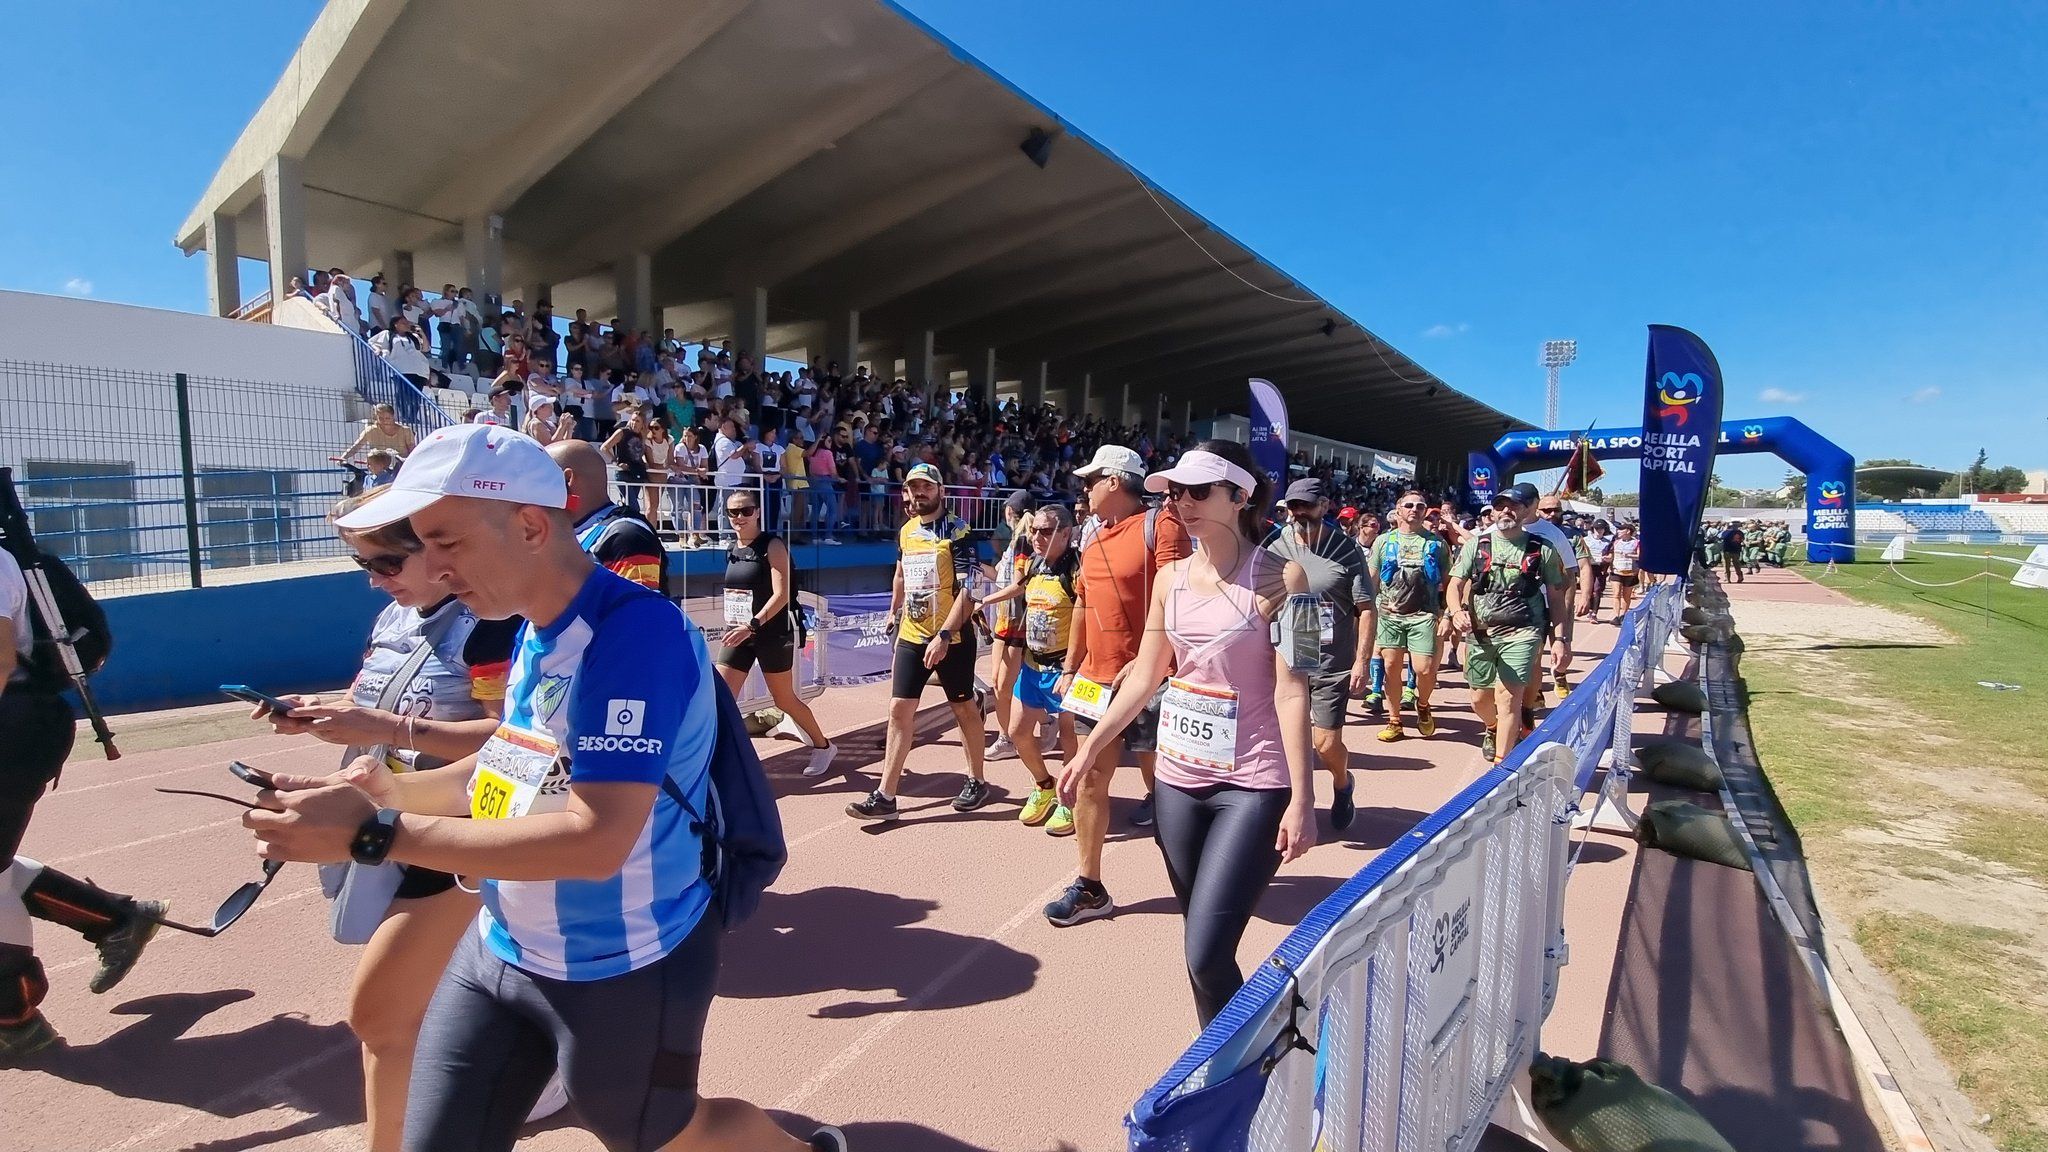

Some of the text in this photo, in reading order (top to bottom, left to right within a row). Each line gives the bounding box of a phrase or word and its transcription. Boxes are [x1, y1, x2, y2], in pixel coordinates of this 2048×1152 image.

[1549, 436, 1642, 451] MELLA SPO
[473, 480, 506, 491] RFET
[1813, 508, 1850, 516] MELILLA
[1816, 515, 1847, 523] SPORT
[1813, 522, 1850, 530] CAPITAL
[1076, 683, 1097, 699] 915
[1172, 713, 1214, 740] 1655
[577, 736, 663, 755] BESOCCER
[480, 781, 507, 819] 867
